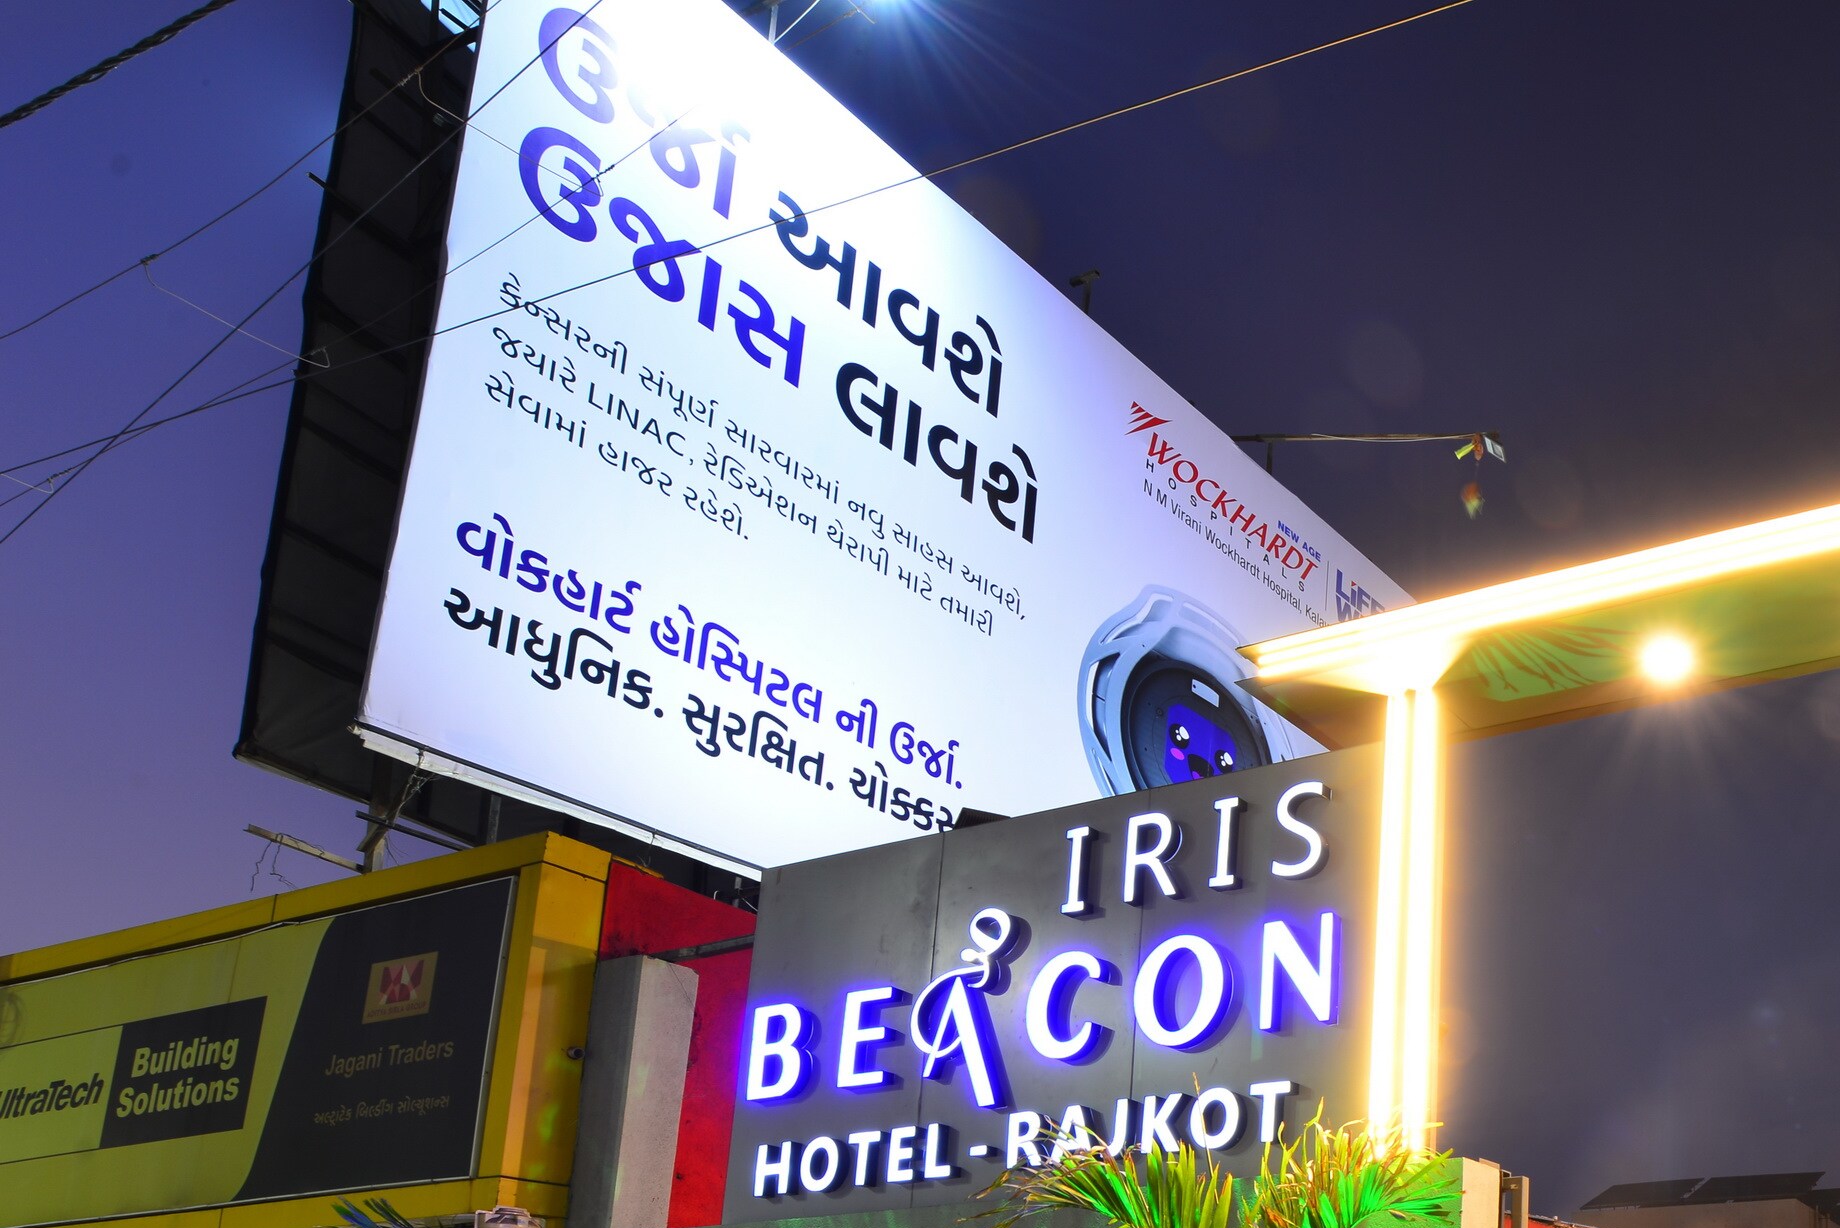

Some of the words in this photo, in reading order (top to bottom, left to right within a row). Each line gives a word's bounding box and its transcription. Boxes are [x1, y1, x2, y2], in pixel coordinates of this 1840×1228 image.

[517, 126, 808, 390] ઉજાસ
[834, 359, 1041, 545] લાવશે
[768, 190, 1004, 418] આવશે
[484, 369, 587, 449] સેવામાં
[598, 440, 673, 497] હાજર
[682, 487, 750, 541] રહેશે.
[499, 272, 628, 375] કેન્સરની
[638, 364, 719, 429] સંપૂર્ણ
[724, 418, 840, 505] સારવારમાં
[892, 522, 953, 574] સાહસ
[960, 564, 1026, 621] આવશે,
[1147, 431, 1319, 581] WOCKHARDT
[702, 442, 818, 535] રેડિએશન
[827, 518, 890, 577] થેરાપી
[897, 566, 933, 601] માટે
[940, 595, 994, 637] તમારી
[1143, 478, 1153, 497] N
[1156, 488, 1168, 508] M
[1170, 498, 1202, 535] Virani
[1205, 525, 1261, 581] Wockhardt
[1263, 571, 1302, 614] Hospital,
[1277, 520, 1299, 543] NEW
[1302, 541, 1321, 562] AGE
[442, 587, 663, 720] આધુનિક.
[681, 691, 835, 792] સુરક્ષિત.
[455, 512, 643, 635] વોકહાર્ટ
[650, 603, 823, 724] હોસ્પિટલ
[834, 698, 877, 750] ની
[888, 719, 964, 790] ઉર્જા.
[1061, 781, 1332, 918] IRIS
[131, 1034, 240, 1080] Building
[325, 1047, 382, 1078] Jagani
[388, 1040, 455, 1066] Traders
[746, 908, 1341, 1109] BEACON
[116, 1076, 240, 1118] Solutions
[753, 1122, 955, 1198] HOTEL
[1006, 1080, 1294, 1170] RAJKOT
